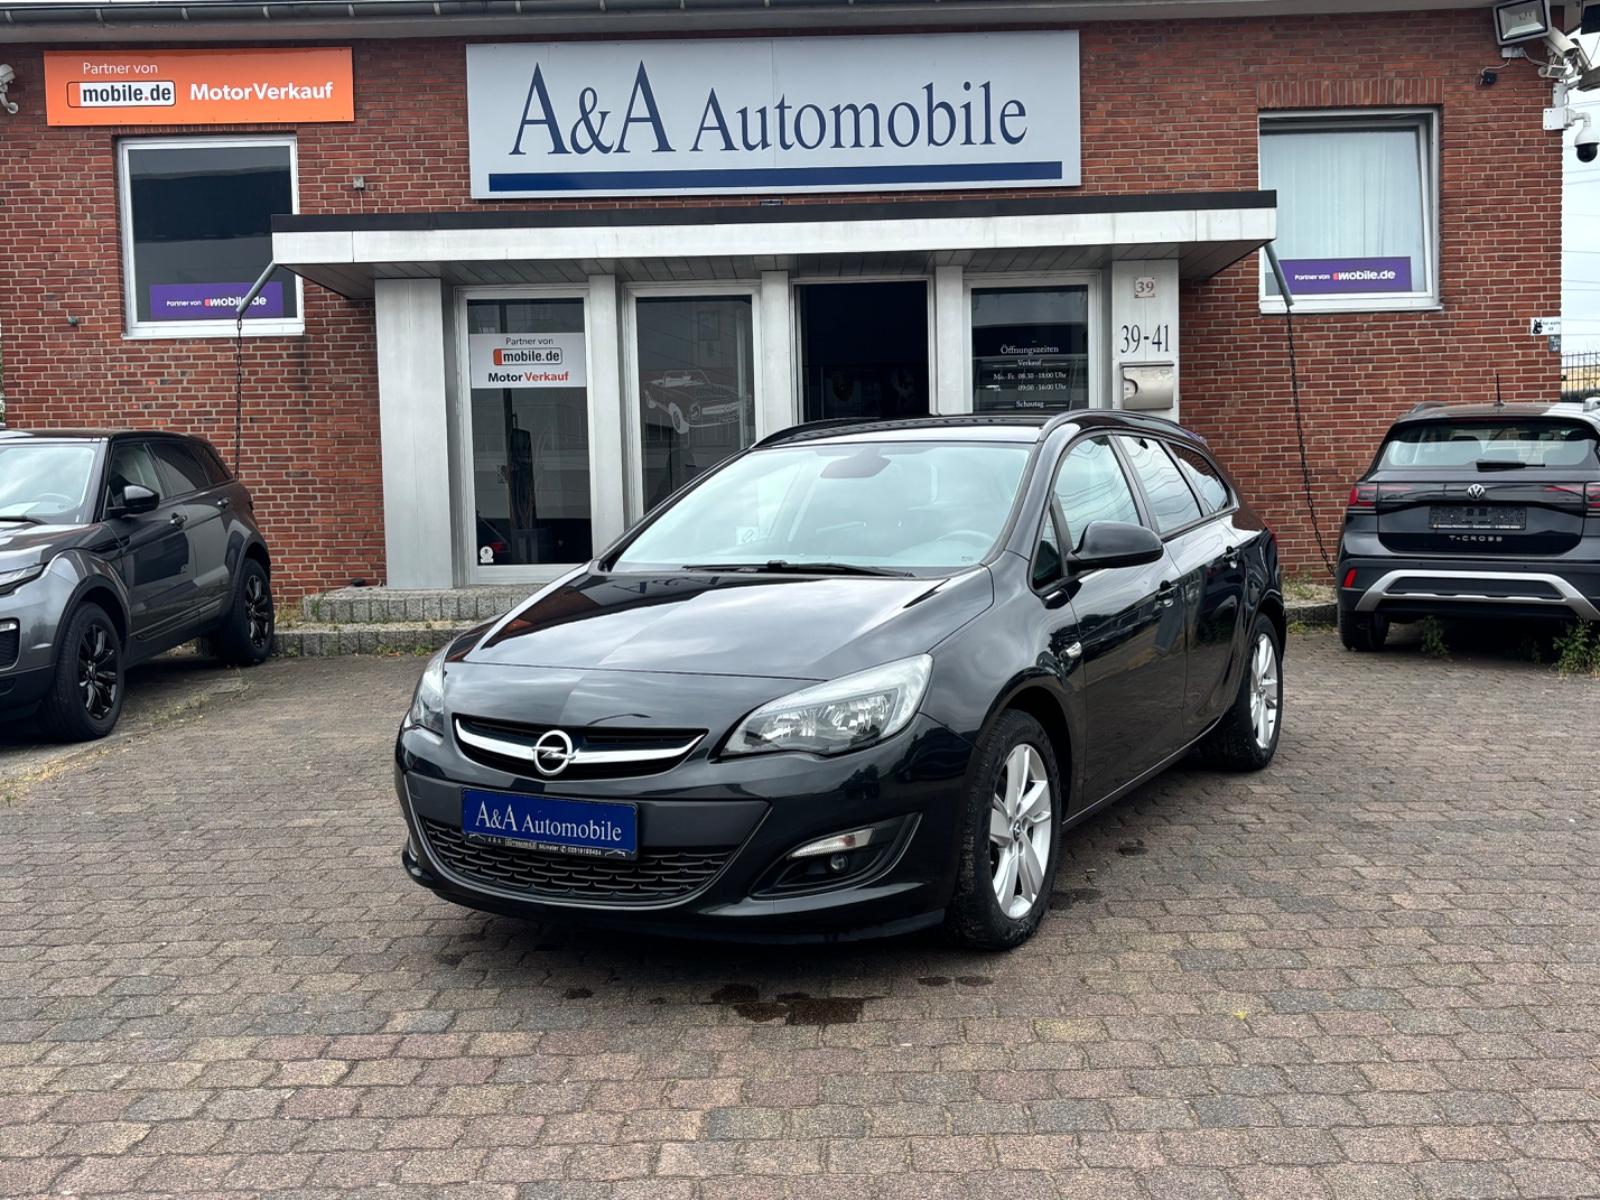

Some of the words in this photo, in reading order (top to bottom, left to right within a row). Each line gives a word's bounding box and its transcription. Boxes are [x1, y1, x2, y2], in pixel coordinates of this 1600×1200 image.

[82, 62, 130, 74] Partner
[133, 63, 158, 74] von
[82, 82, 172, 103] mobile.de
[508, 59, 676, 156] A&A
[689, 80, 1029, 152] Automobile
[1338, 270, 1395, 281] mobile.de
[1136, 281, 1154, 293] 39
[506, 337, 536, 345] Partner
[538, 337, 554, 345] von
[1121, 324, 1169, 354] 39-41
[503, 350, 560, 362] mobile.de
[475, 800, 518, 832] A&A
[521, 813, 623, 842] Automobile
